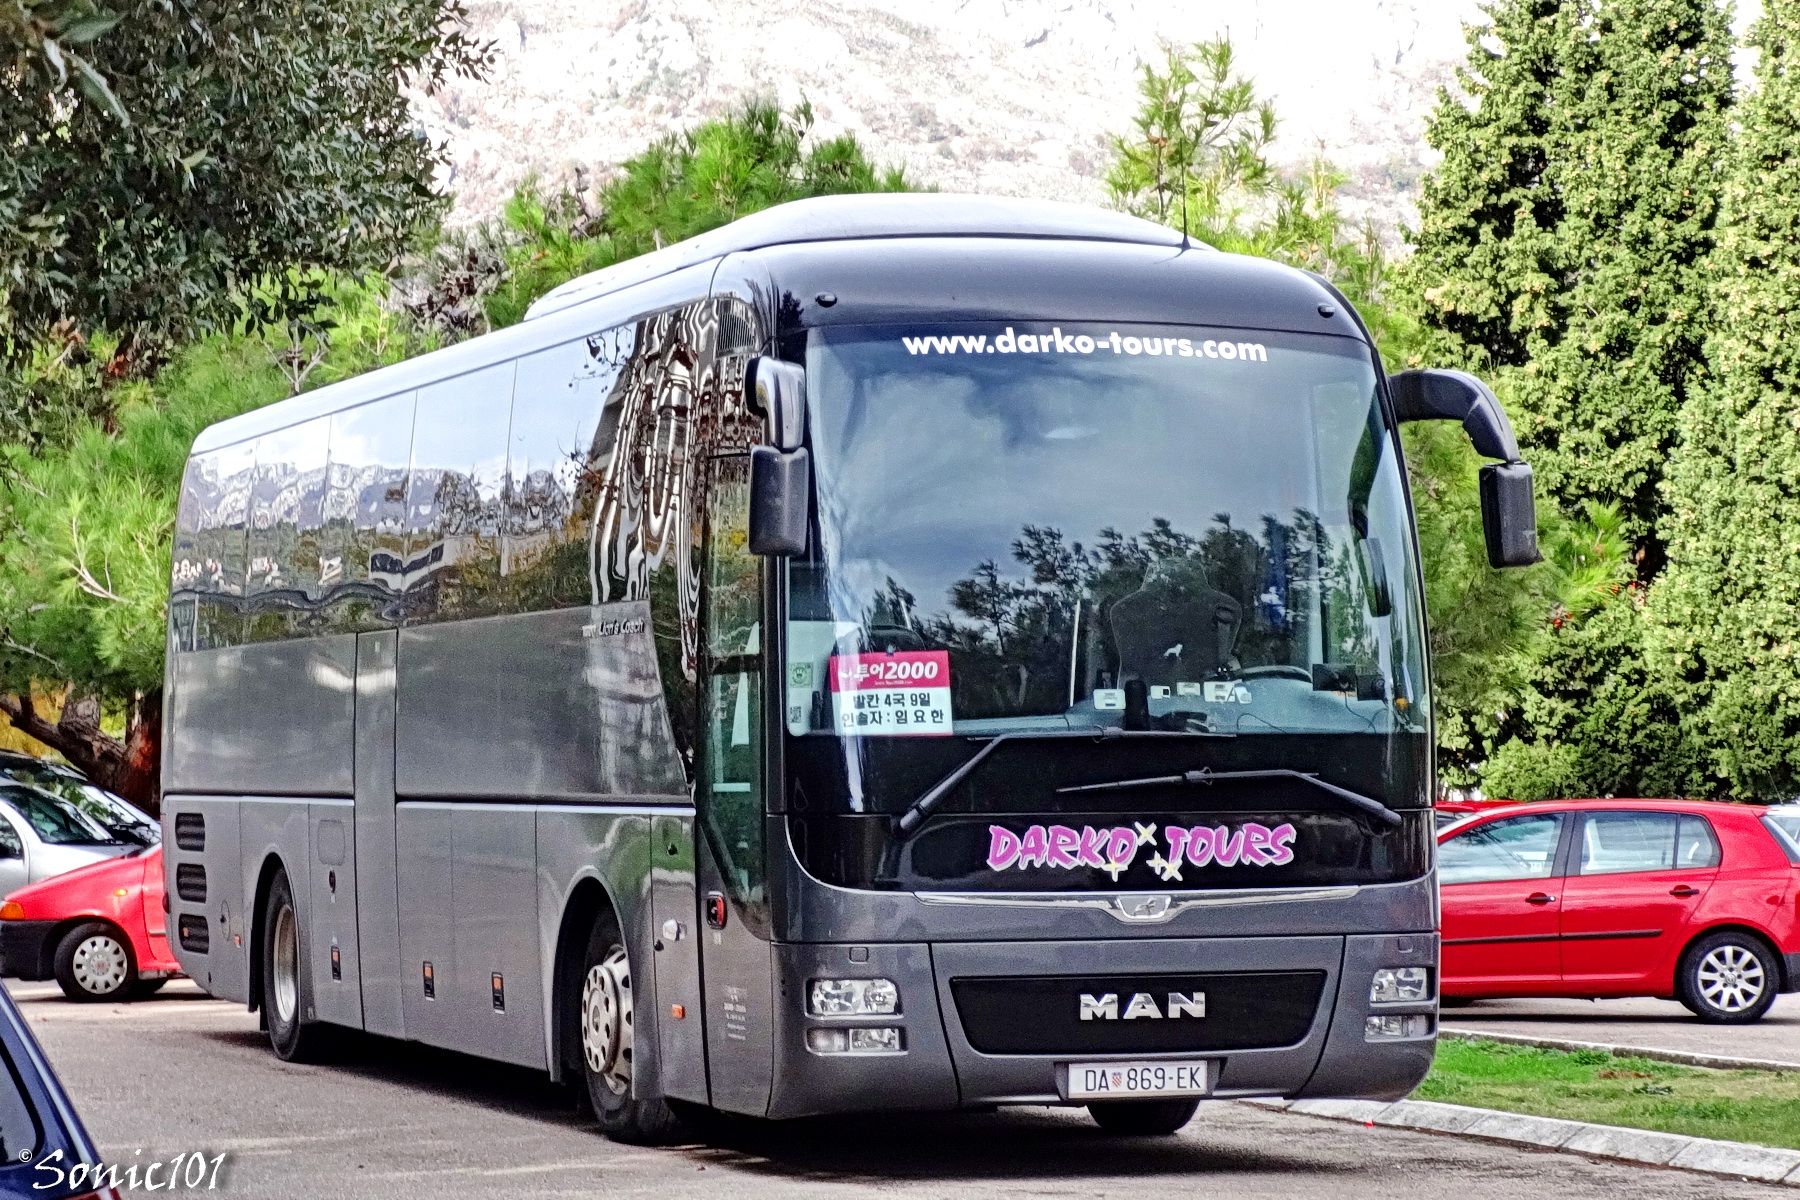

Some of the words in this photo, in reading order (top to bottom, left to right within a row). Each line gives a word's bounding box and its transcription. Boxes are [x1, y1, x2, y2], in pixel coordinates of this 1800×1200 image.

[902, 327, 1268, 362] www.darko-tours.com
[853, 693, 879, 709] 발칸
[884, 693, 905, 707] 4국
[910, 692, 931, 707] 9일
[986, 824, 1139, 871] DARKO
[1165, 822, 1297, 869] TOURS
[1079, 991, 1206, 1021] MAN
